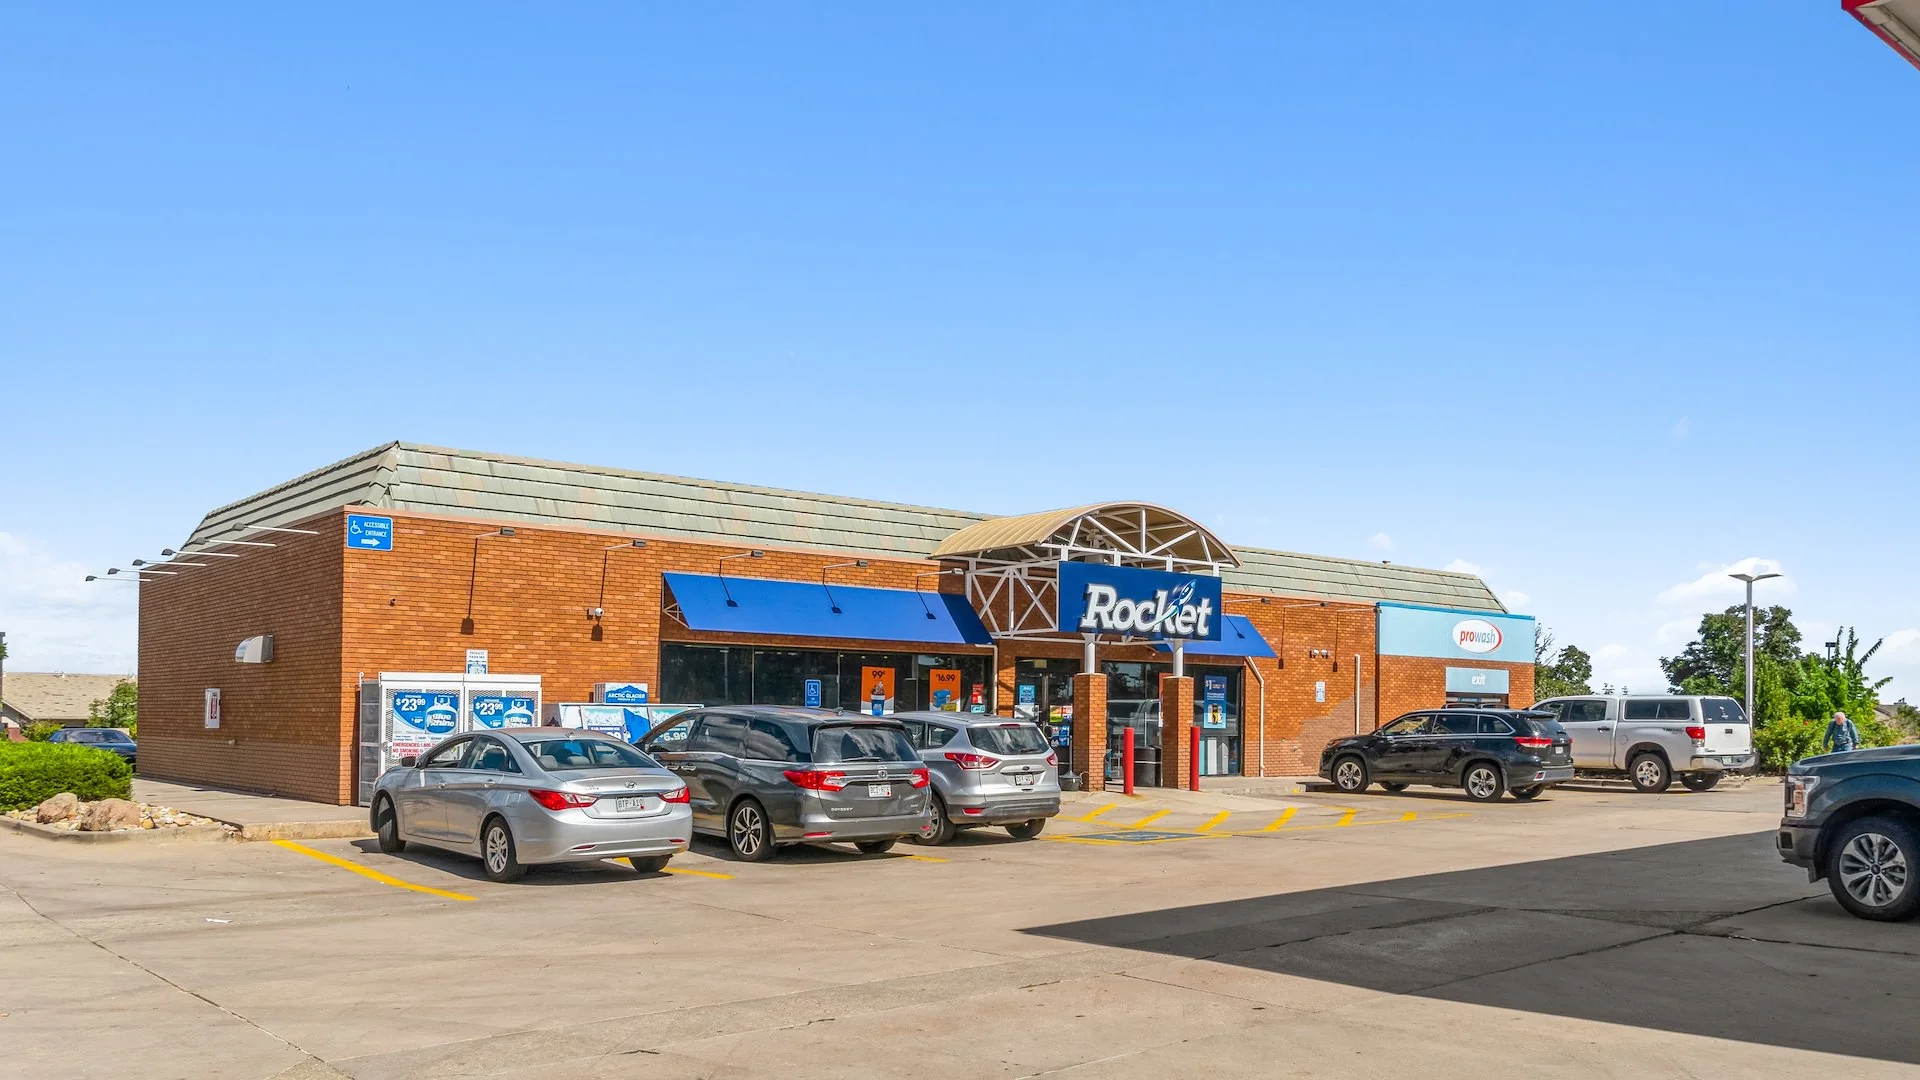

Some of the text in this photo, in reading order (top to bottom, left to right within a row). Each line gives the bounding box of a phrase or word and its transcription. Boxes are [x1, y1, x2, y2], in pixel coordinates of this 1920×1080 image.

[364, 521, 389, 529] ACCESSIBLE
[1080, 583, 1213, 636] Rocket
[1460, 629, 1496, 645] prowash
[1471, 673, 1486, 685] exit
